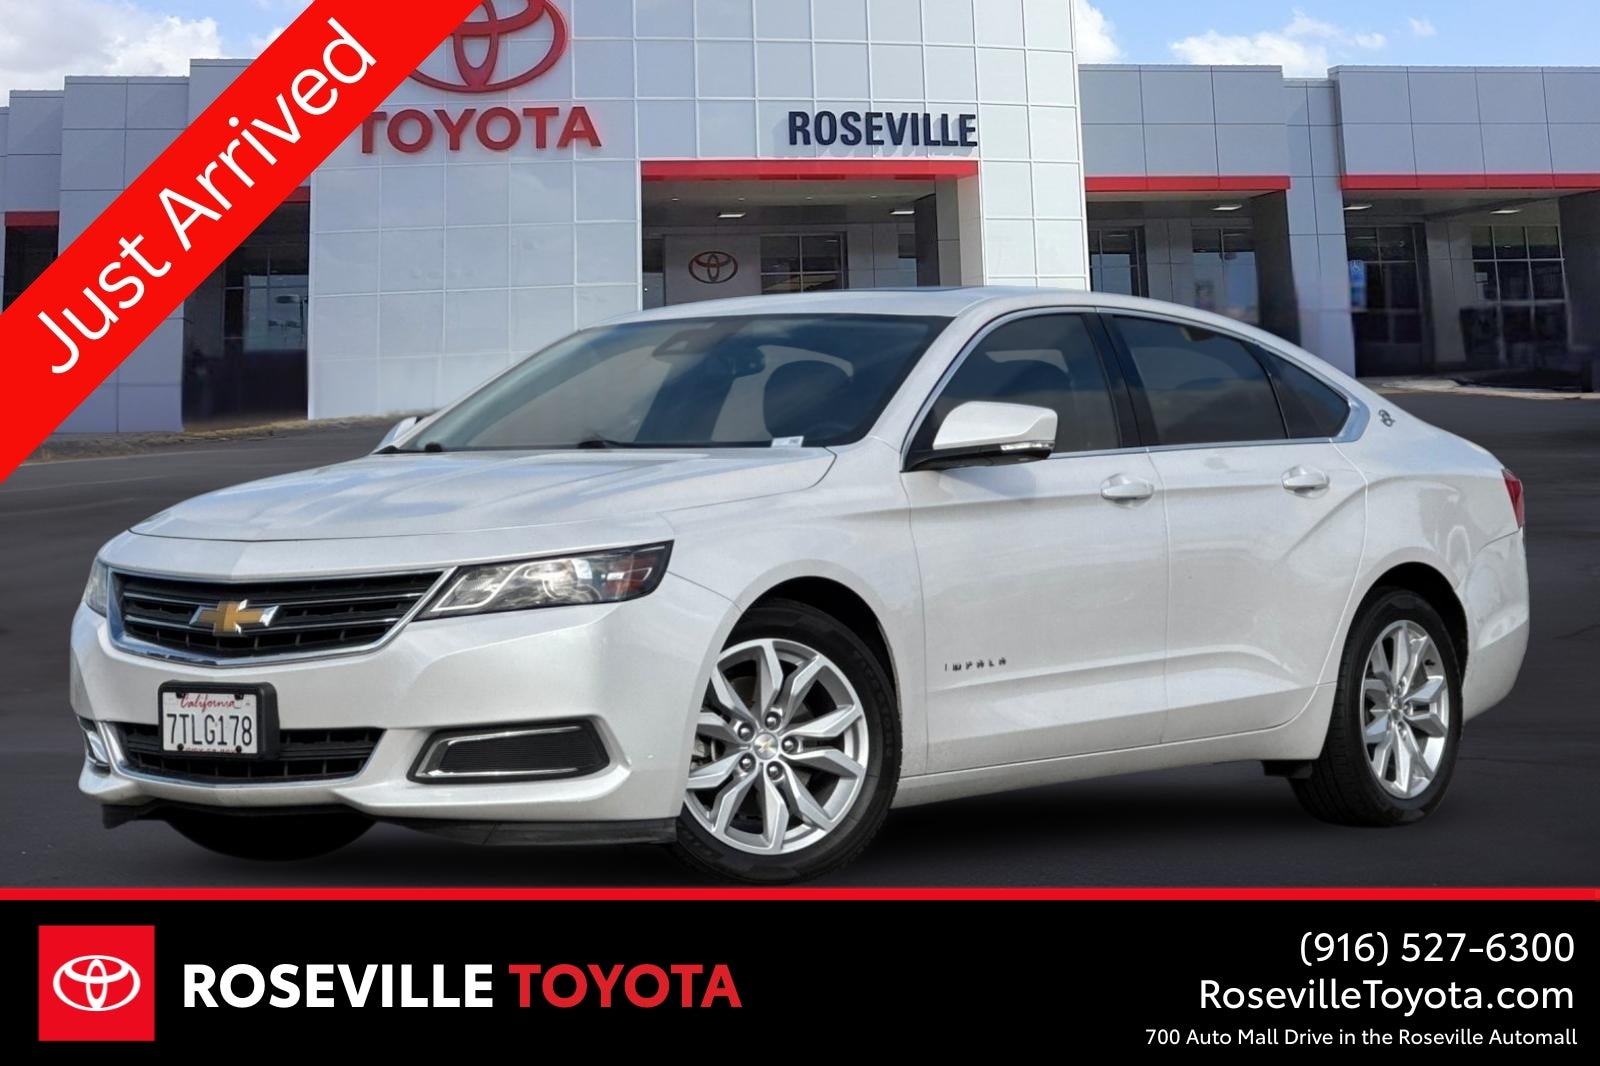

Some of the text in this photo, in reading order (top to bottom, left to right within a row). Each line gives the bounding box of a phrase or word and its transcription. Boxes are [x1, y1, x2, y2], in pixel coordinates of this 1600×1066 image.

[361, 106, 602, 154] TOYOTA
[788, 110, 978, 147] ROSEVILLE
[180, 693, 240, 712] California
[166, 713, 252, 746] 7TLG178
